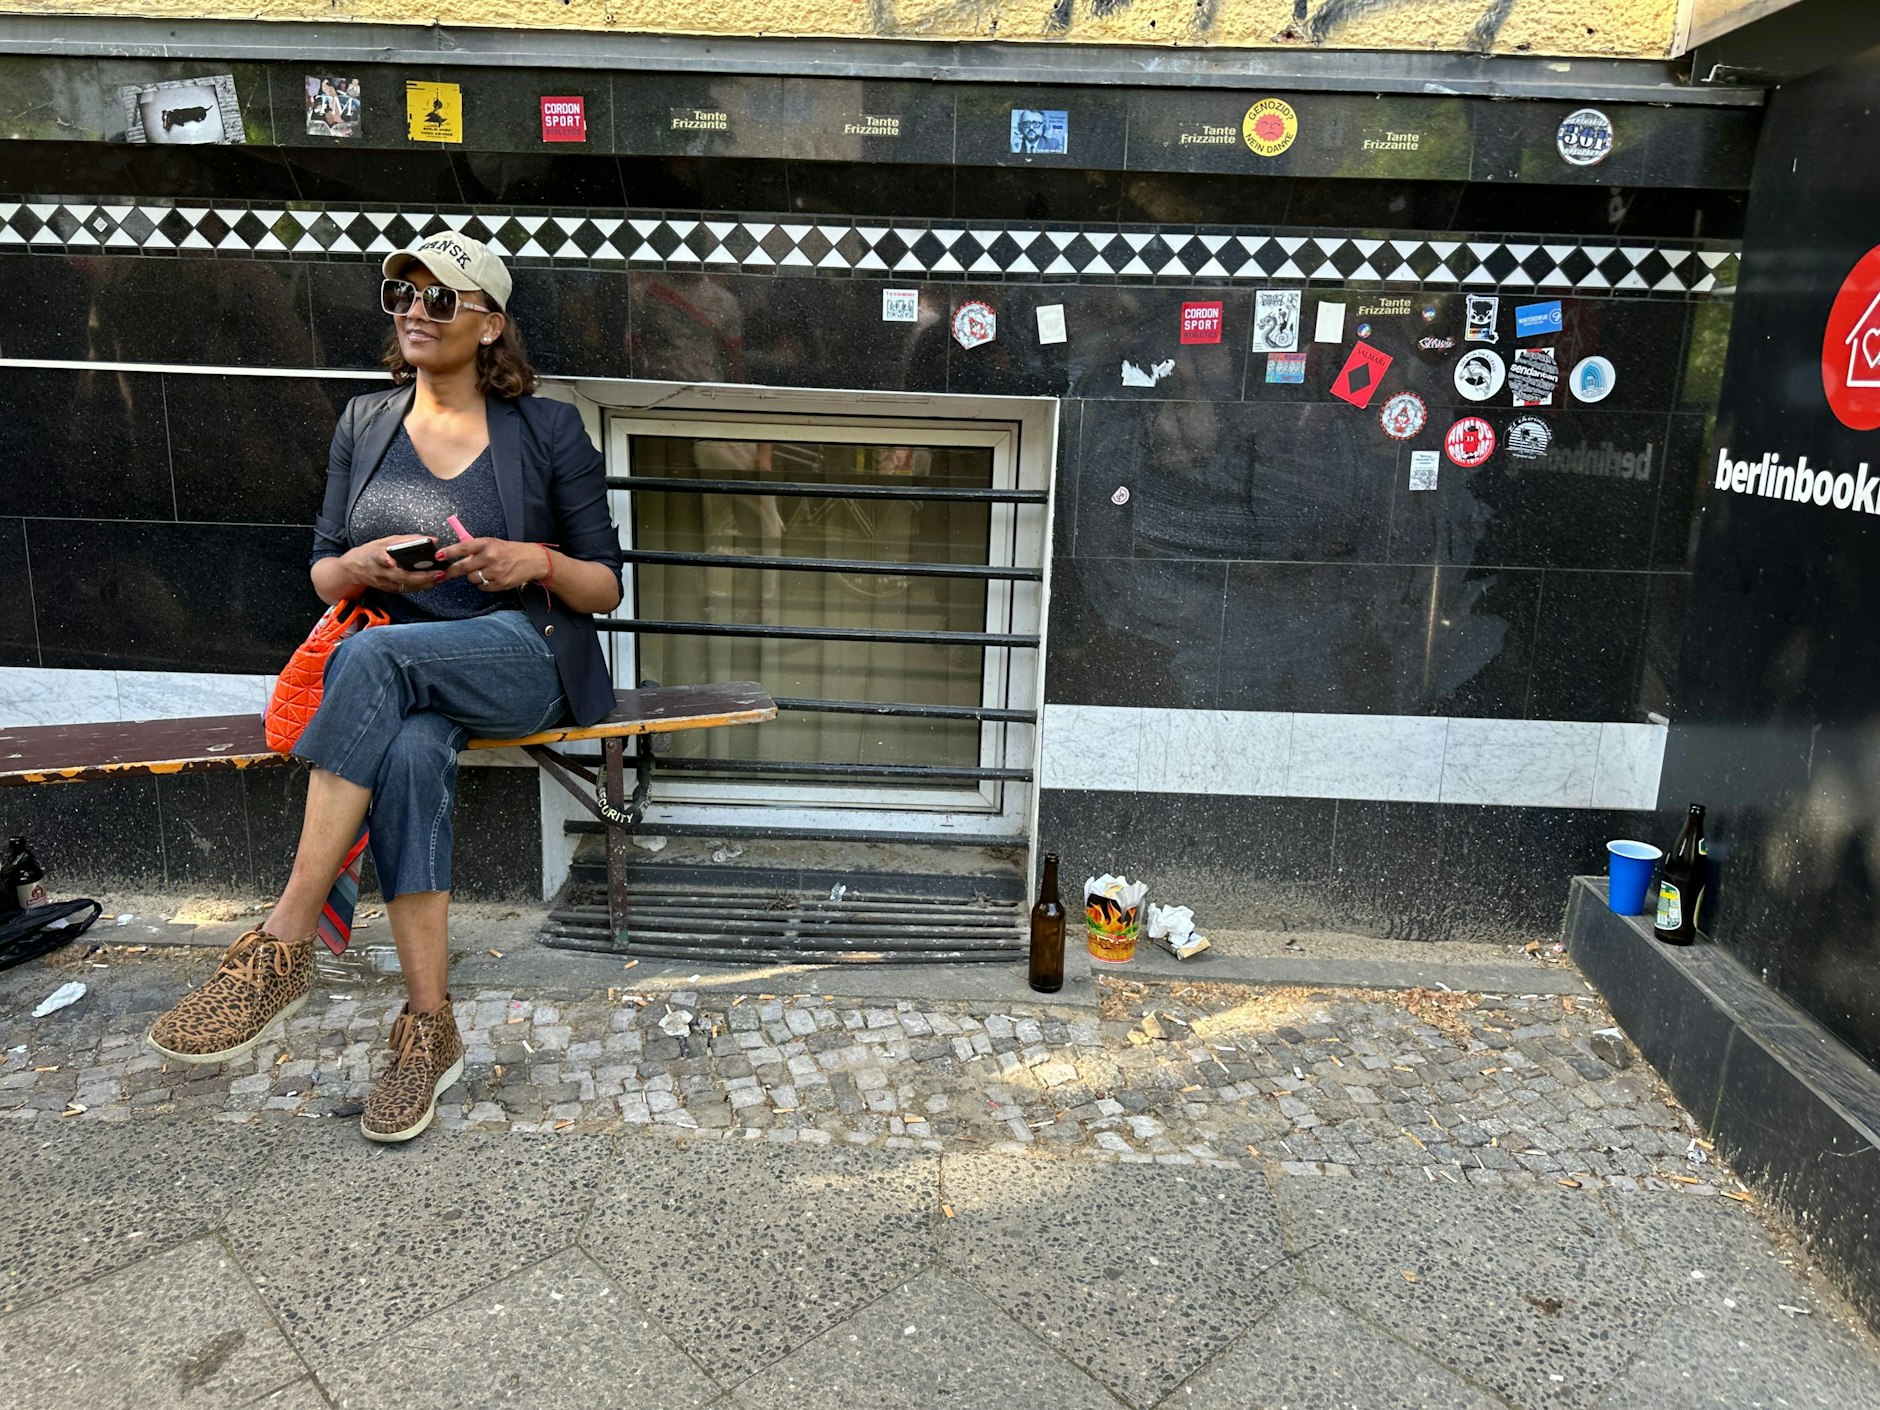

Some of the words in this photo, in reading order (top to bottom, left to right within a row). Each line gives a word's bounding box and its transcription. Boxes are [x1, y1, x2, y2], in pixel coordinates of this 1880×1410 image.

[544, 102, 581, 115] CORDON
[1247, 99, 1295, 121] GENOZID?
[545, 115, 581, 127] SPORT
[693, 111, 727, 121] Tante
[866, 116, 899, 126] Tante
[672, 119, 727, 130] Frizzante
[845, 124, 899, 135] Frizzante
[1203, 126, 1236, 136] Tante
[1181, 134, 1236, 145] Frizzante
[1245, 132, 1265, 153] NEIN
[1266, 131, 1294, 154] DANKE
[1386, 132, 1419, 142] Tante
[1364, 140, 1419, 151] Frizzante
[1379, 298, 1411, 307] Tante
[1184, 308, 1219, 319] CORDON
[1358, 306, 1411, 315] Frizzante
[1184, 320, 1218, 331] SPORT
[1357, 348, 1386, 366] SALMARI
[598, 786, 633, 824] SECURITY
